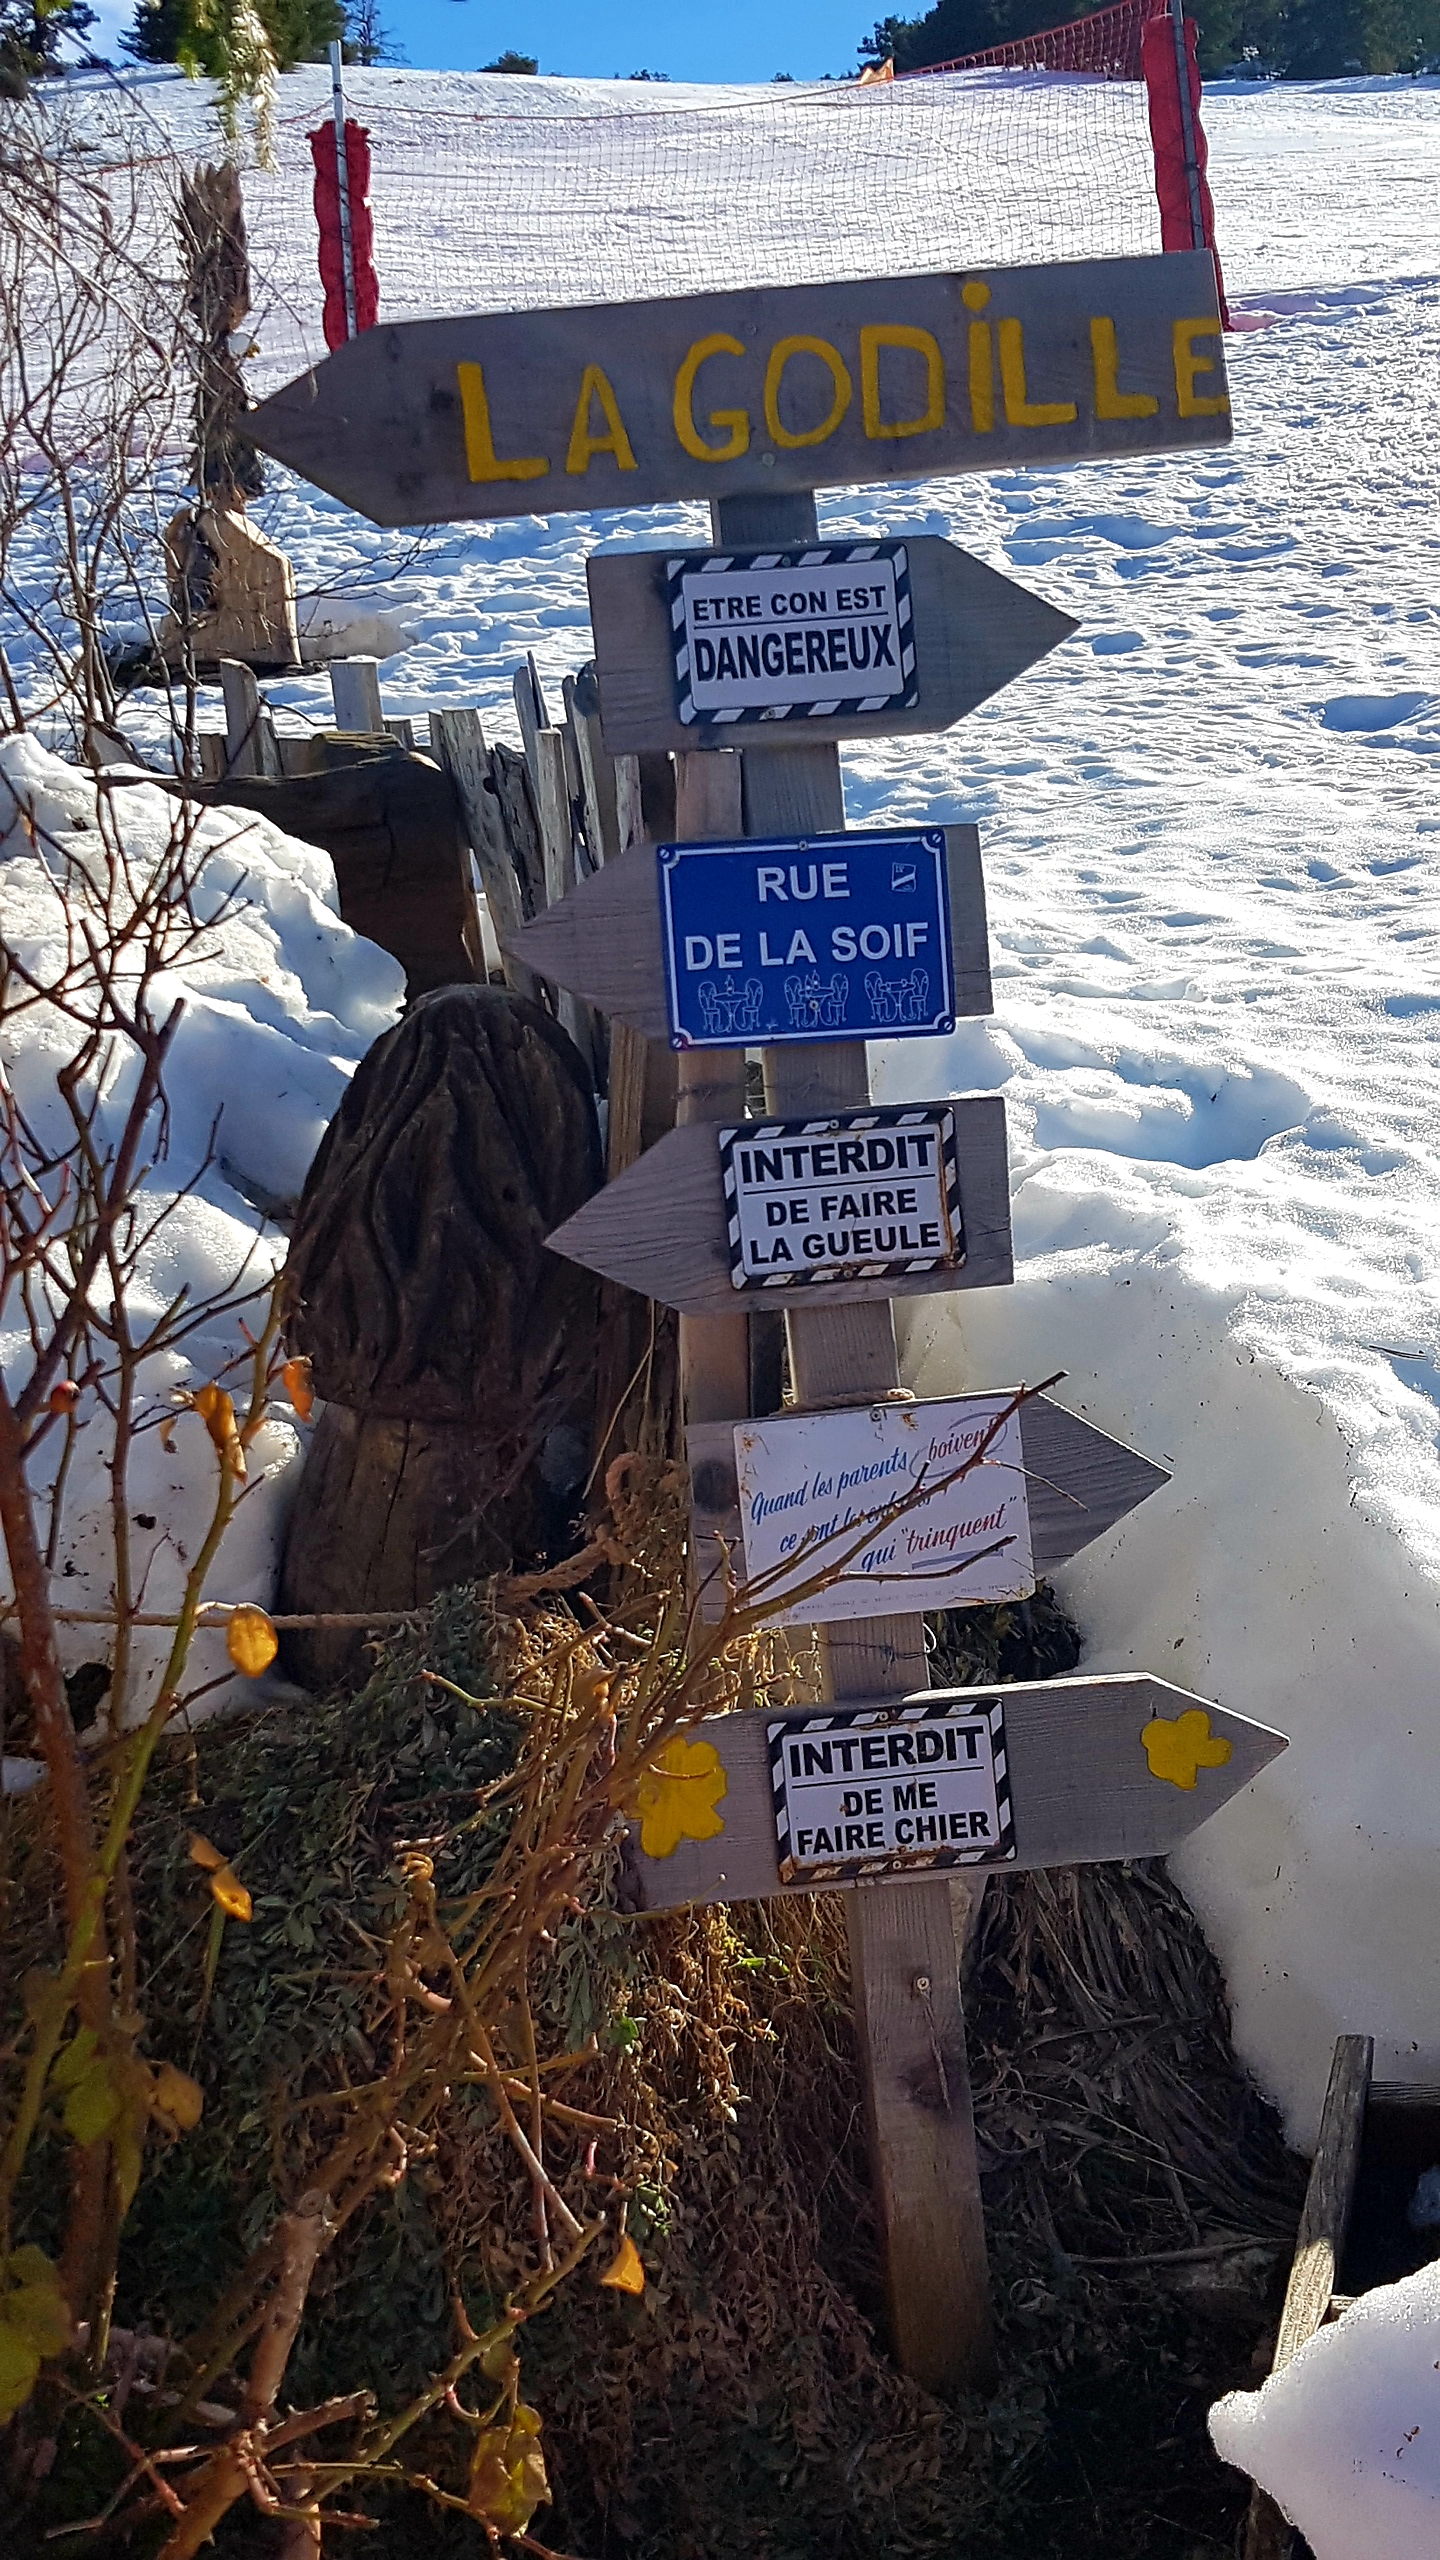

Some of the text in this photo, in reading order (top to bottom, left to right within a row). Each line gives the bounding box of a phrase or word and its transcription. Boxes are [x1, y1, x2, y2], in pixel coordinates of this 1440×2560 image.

[457, 361, 638, 484] LA
[693, 585, 887, 622] ETRE CON EST
[694, 623, 896, 682] DANGEREUX
[757, 862, 850, 902] RUE
[685, 922, 929, 971] DE LA SOIF
[740, 1133, 935, 1184] INTERDIT
[766, 1188, 918, 1227] DE FAIRE
[750, 1222, 941, 1265] LA GUEULE
[751, 1481, 809, 1526] Quand
[812, 1471, 833, 1499] les
[837, 1446, 908, 1499] parents
[780, 1532, 798, 1553] ce
[861, 1539, 896, 1572] qui
[789, 1725, 984, 1778] INTERDIT
[843, 1781, 938, 1817] DE ME
[797, 1811, 991, 1856] FAIRE CHIER
